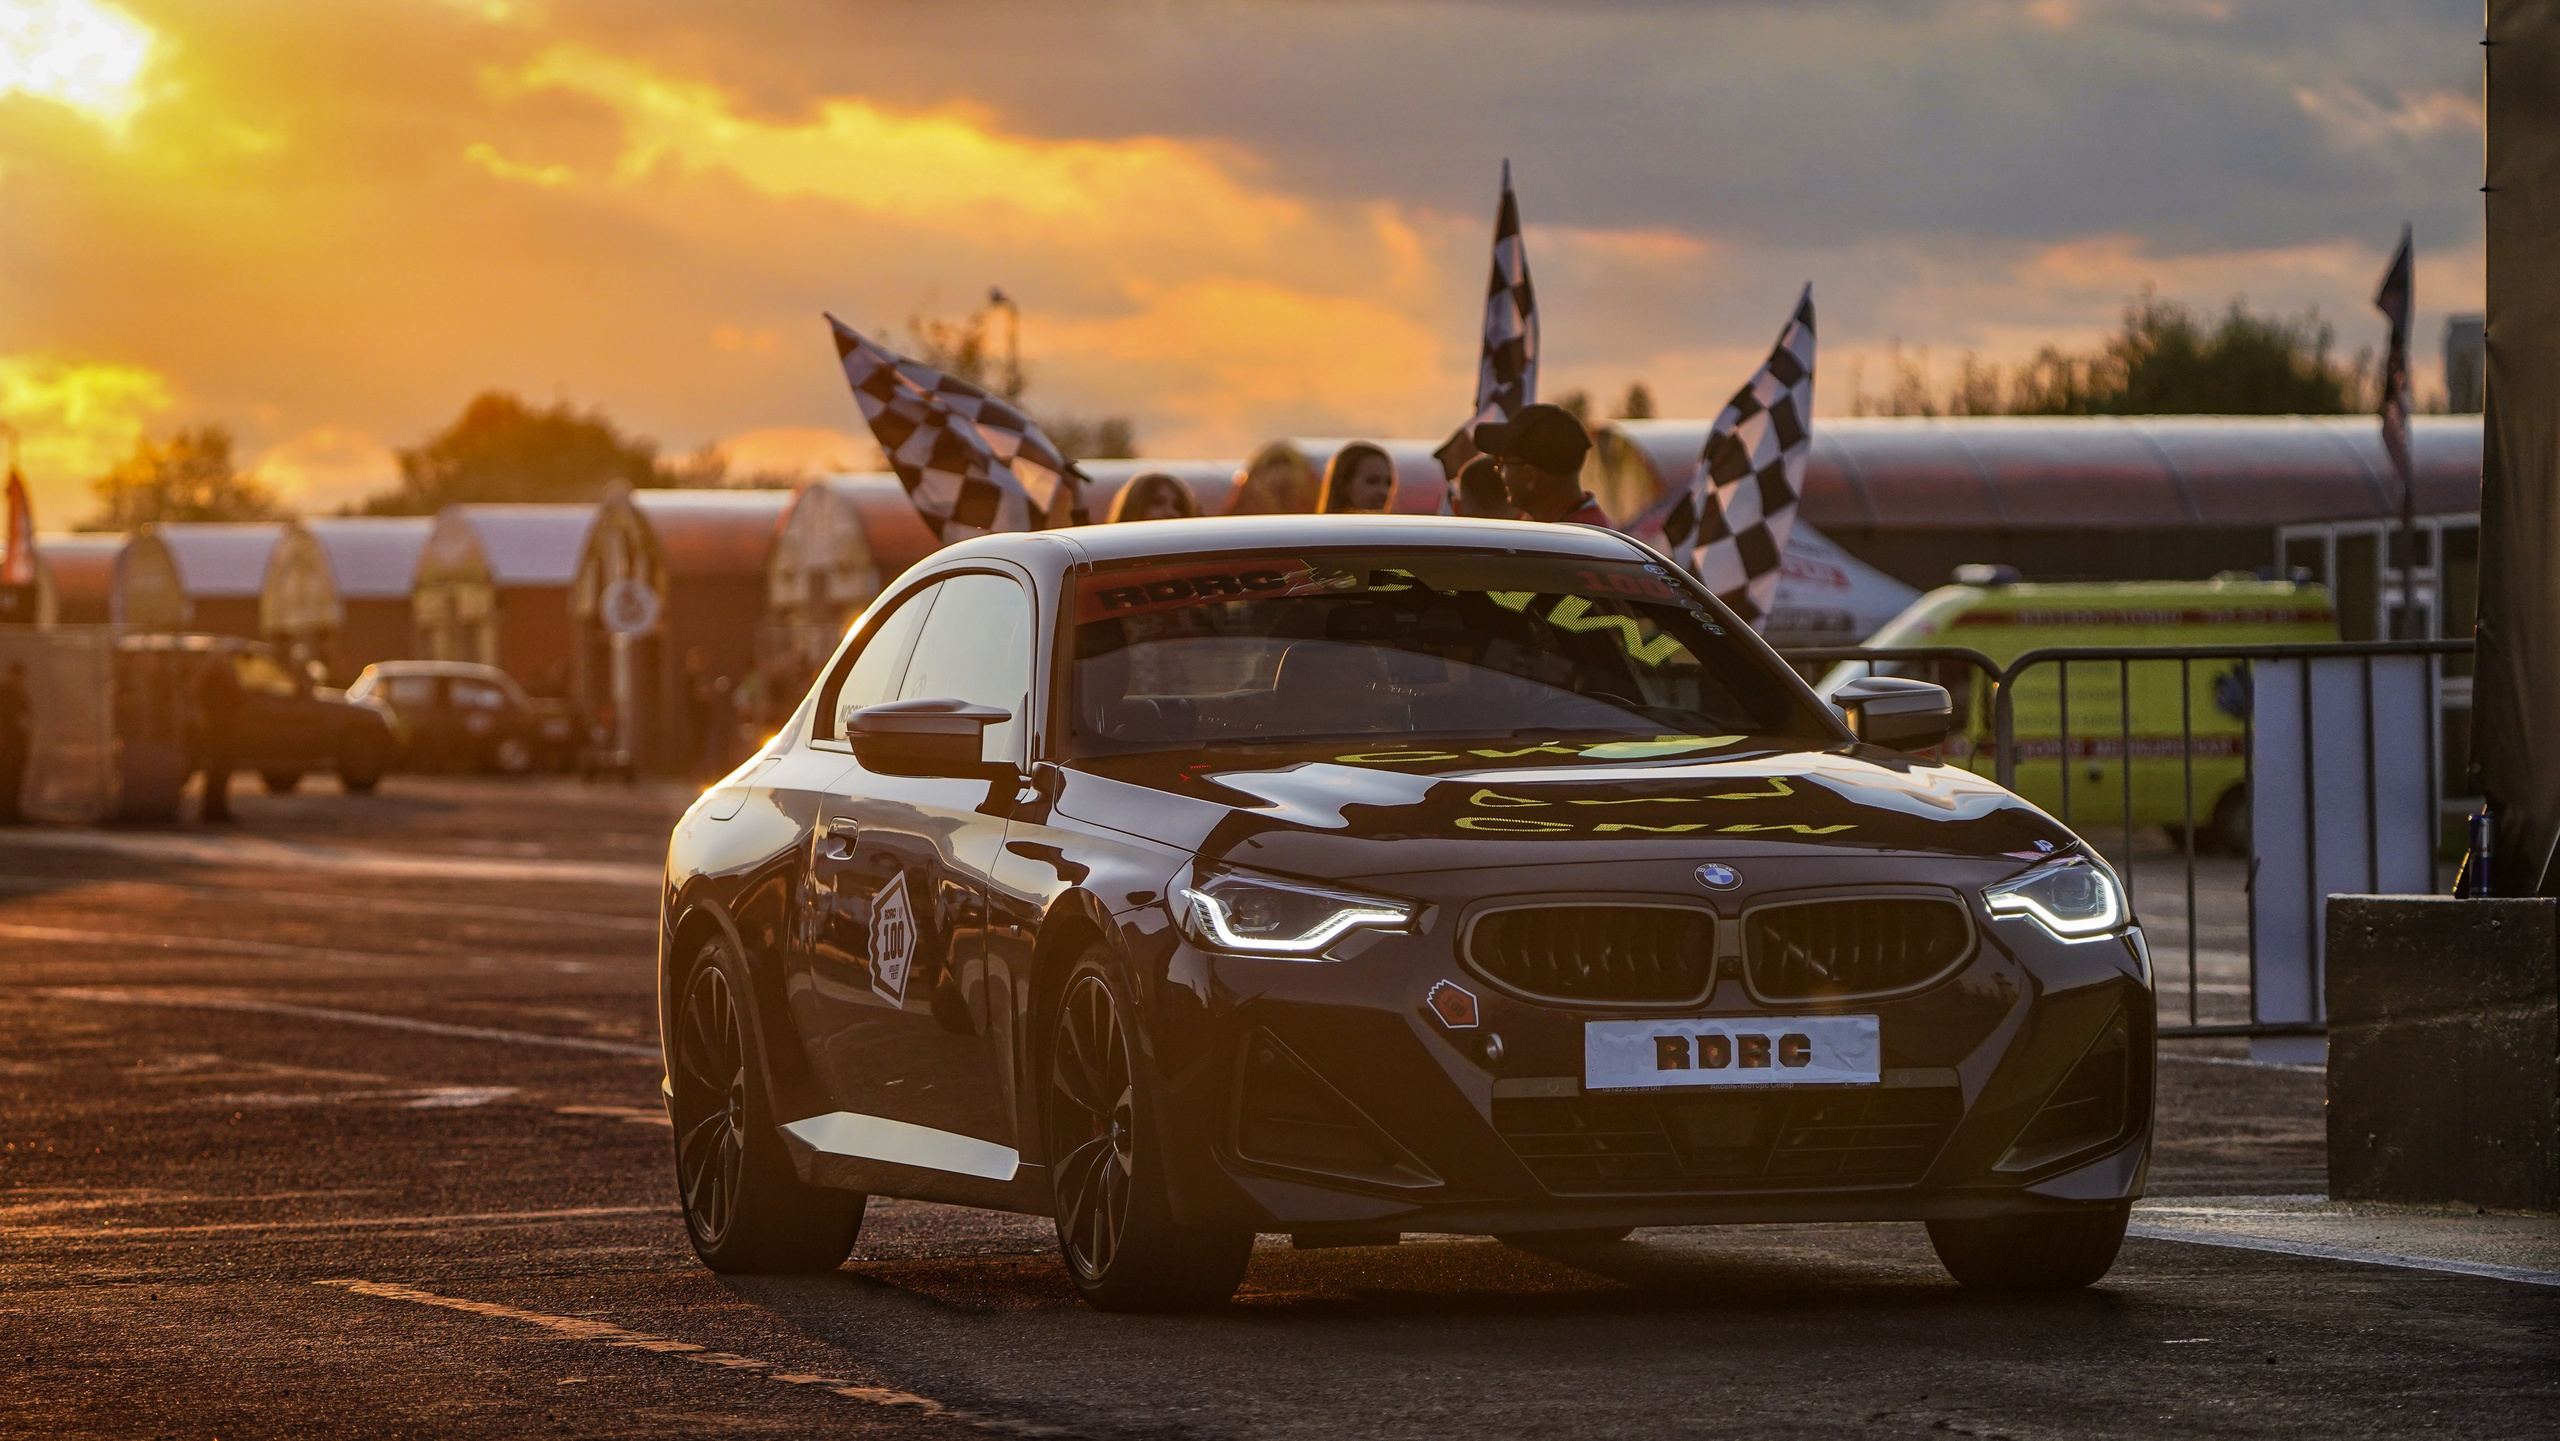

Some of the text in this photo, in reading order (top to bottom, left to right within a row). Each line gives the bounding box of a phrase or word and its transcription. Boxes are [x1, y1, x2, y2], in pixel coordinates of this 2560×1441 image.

[1095, 569, 1287, 611] RDRC
[1576, 571, 1673, 599] 100
[1697, 862, 1735, 873] BMW
[884, 921, 905, 961] 100
[1653, 1033, 1812, 1071] RDRC
